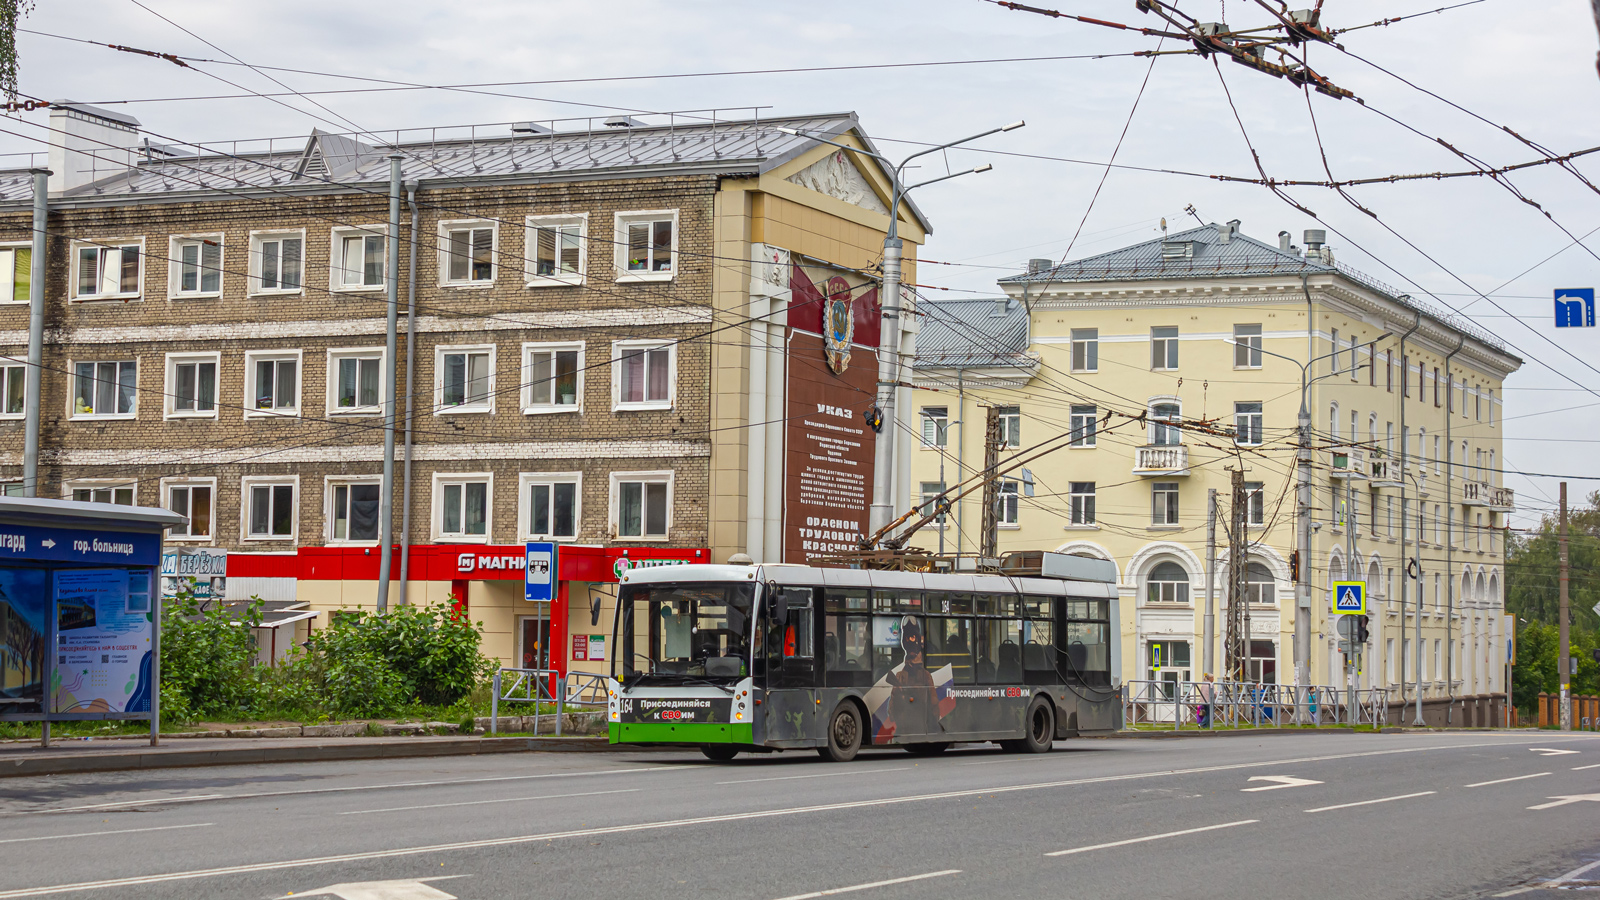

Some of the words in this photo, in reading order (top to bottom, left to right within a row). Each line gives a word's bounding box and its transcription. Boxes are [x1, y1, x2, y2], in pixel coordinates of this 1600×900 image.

[817, 404, 852, 419] УКАЗ
[74, 540, 90, 554] гор.
[93, 538, 133, 556] больница
[180, 551, 226, 574] БЕРЁЗКА
[194, 585, 210, 594] КАФЕ
[946, 688, 999, 699] Присоединяйся
[1006, 687, 1030, 697] СВОим
[620, 699, 633, 713] 164
[641, 699, 711, 709] Присоединяйся
[662, 711, 694, 719] СВОим
